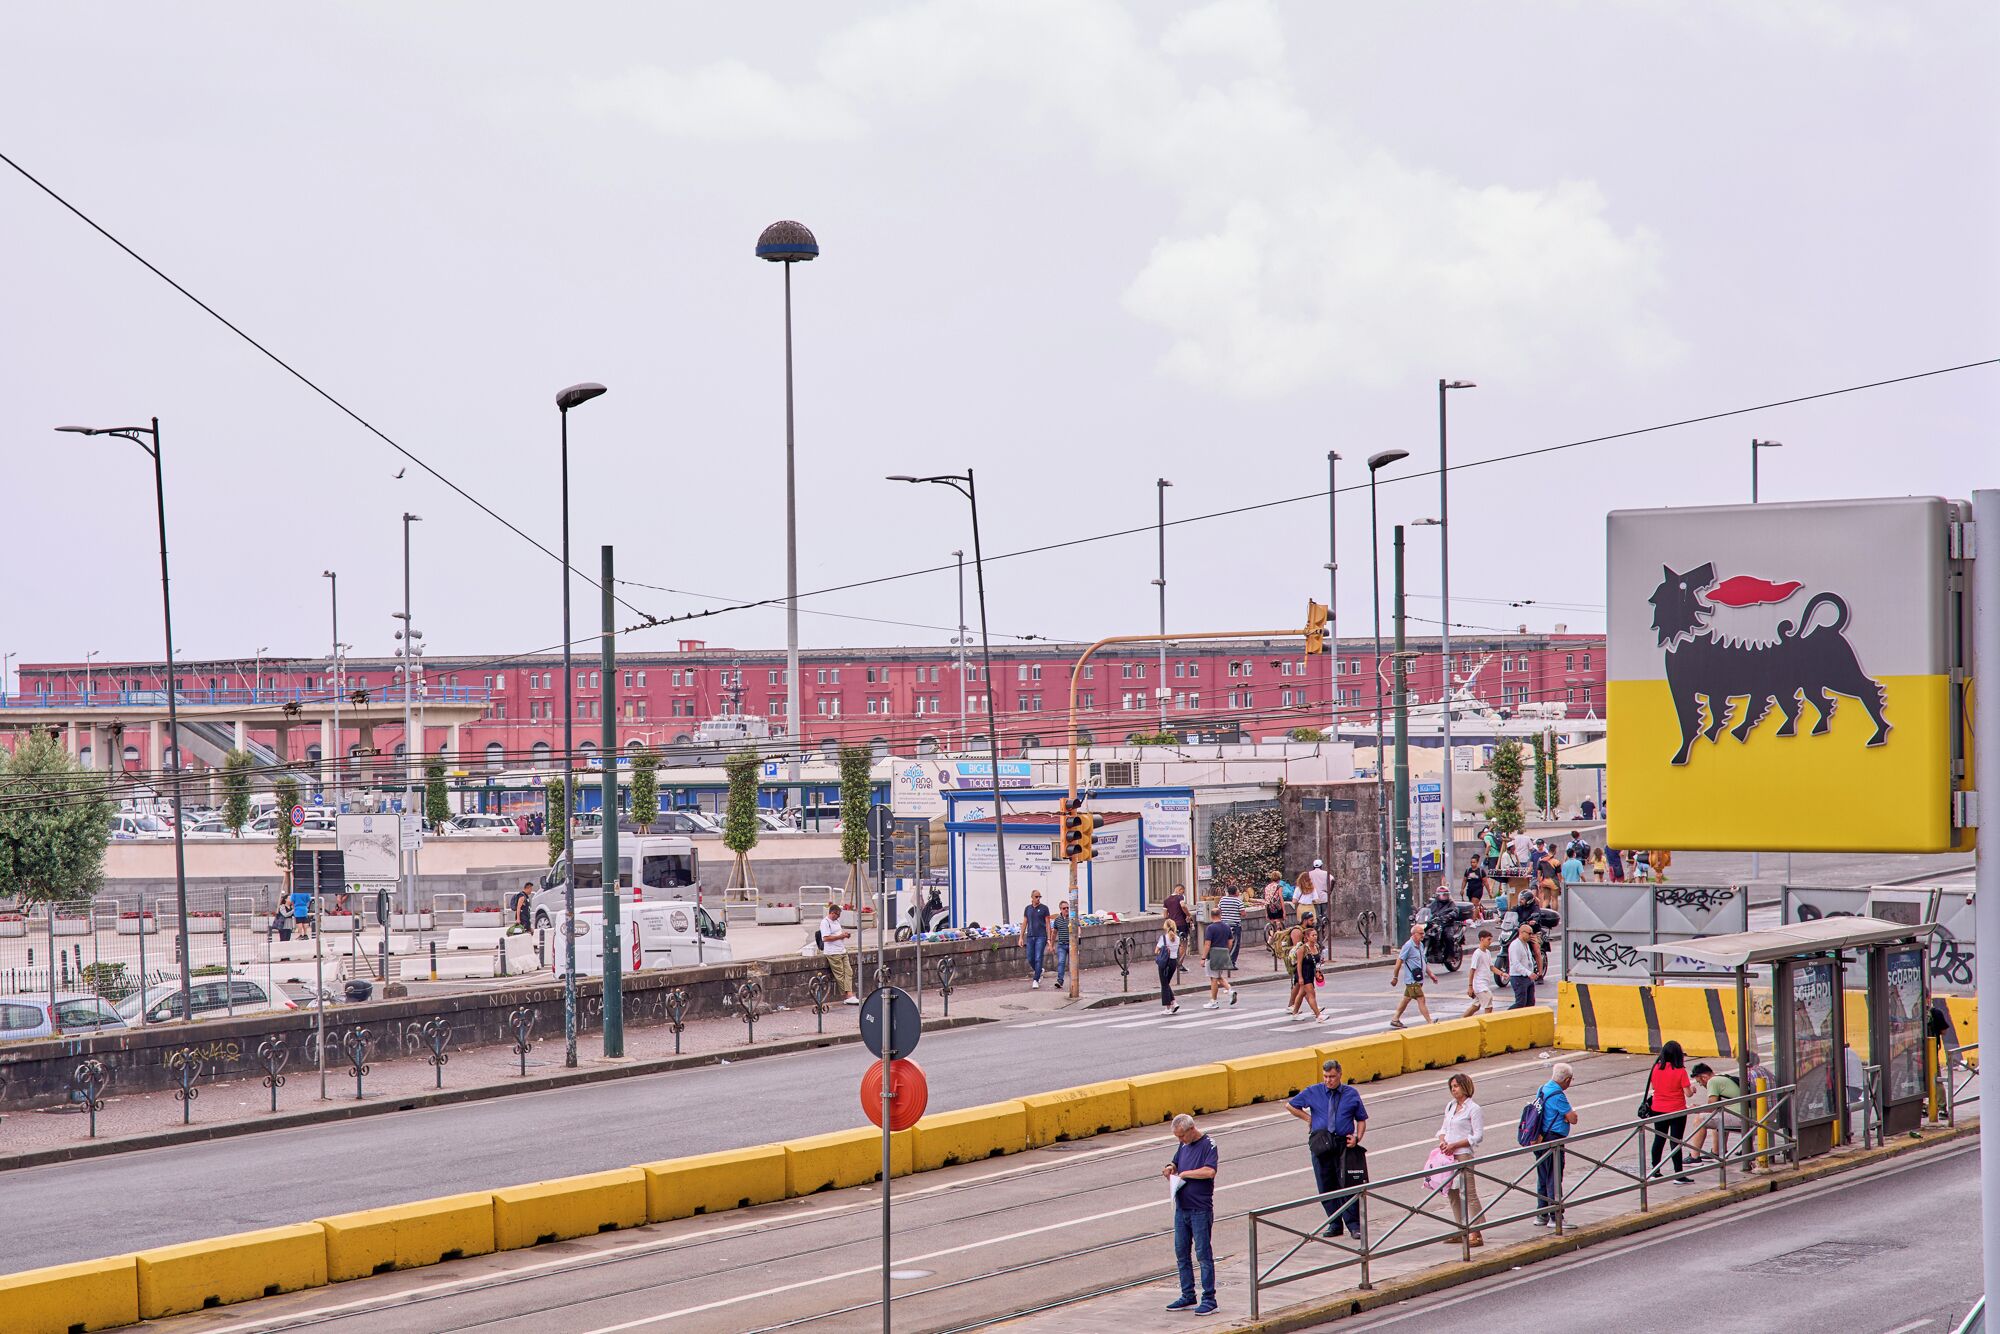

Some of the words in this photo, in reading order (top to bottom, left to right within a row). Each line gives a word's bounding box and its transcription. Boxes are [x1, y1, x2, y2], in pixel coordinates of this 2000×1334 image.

[766, 764, 774, 774] P
[1888, 966, 1920, 987] SGUARDI
[1793, 981, 1831, 1002] SGUARDI
